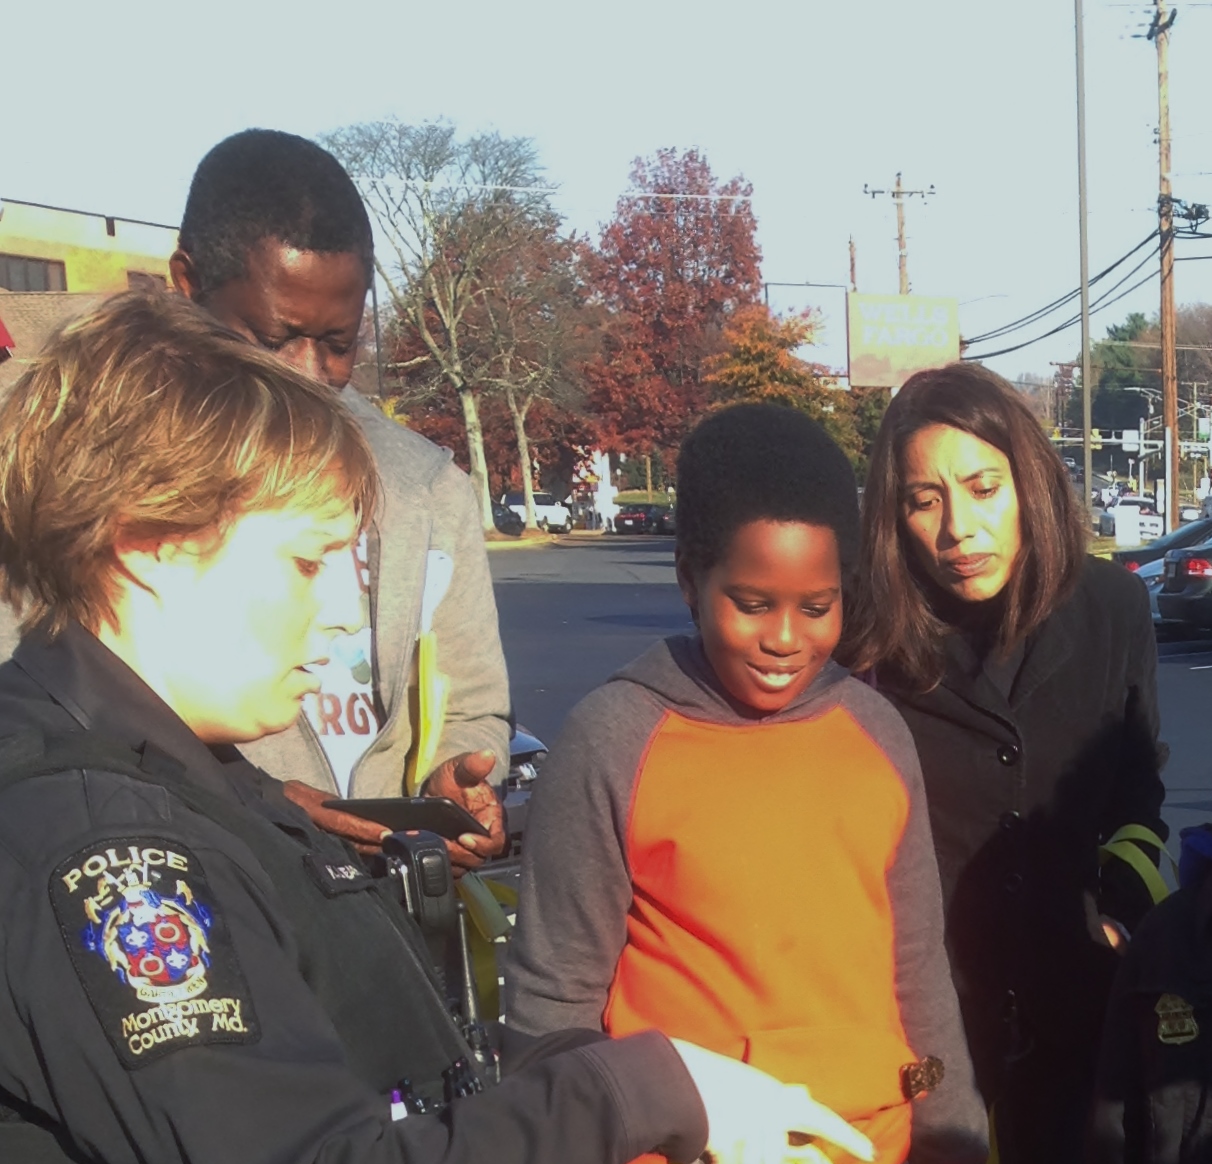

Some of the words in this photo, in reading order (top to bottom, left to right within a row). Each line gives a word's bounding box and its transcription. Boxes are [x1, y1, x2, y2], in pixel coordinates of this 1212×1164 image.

[858, 303, 950, 325] WELLS
[863, 325, 950, 347] FARGO
[62, 846, 188, 893] POLICE
[121, 998, 241, 1037] Montgomery
[211, 1013, 249, 1033] Md.
